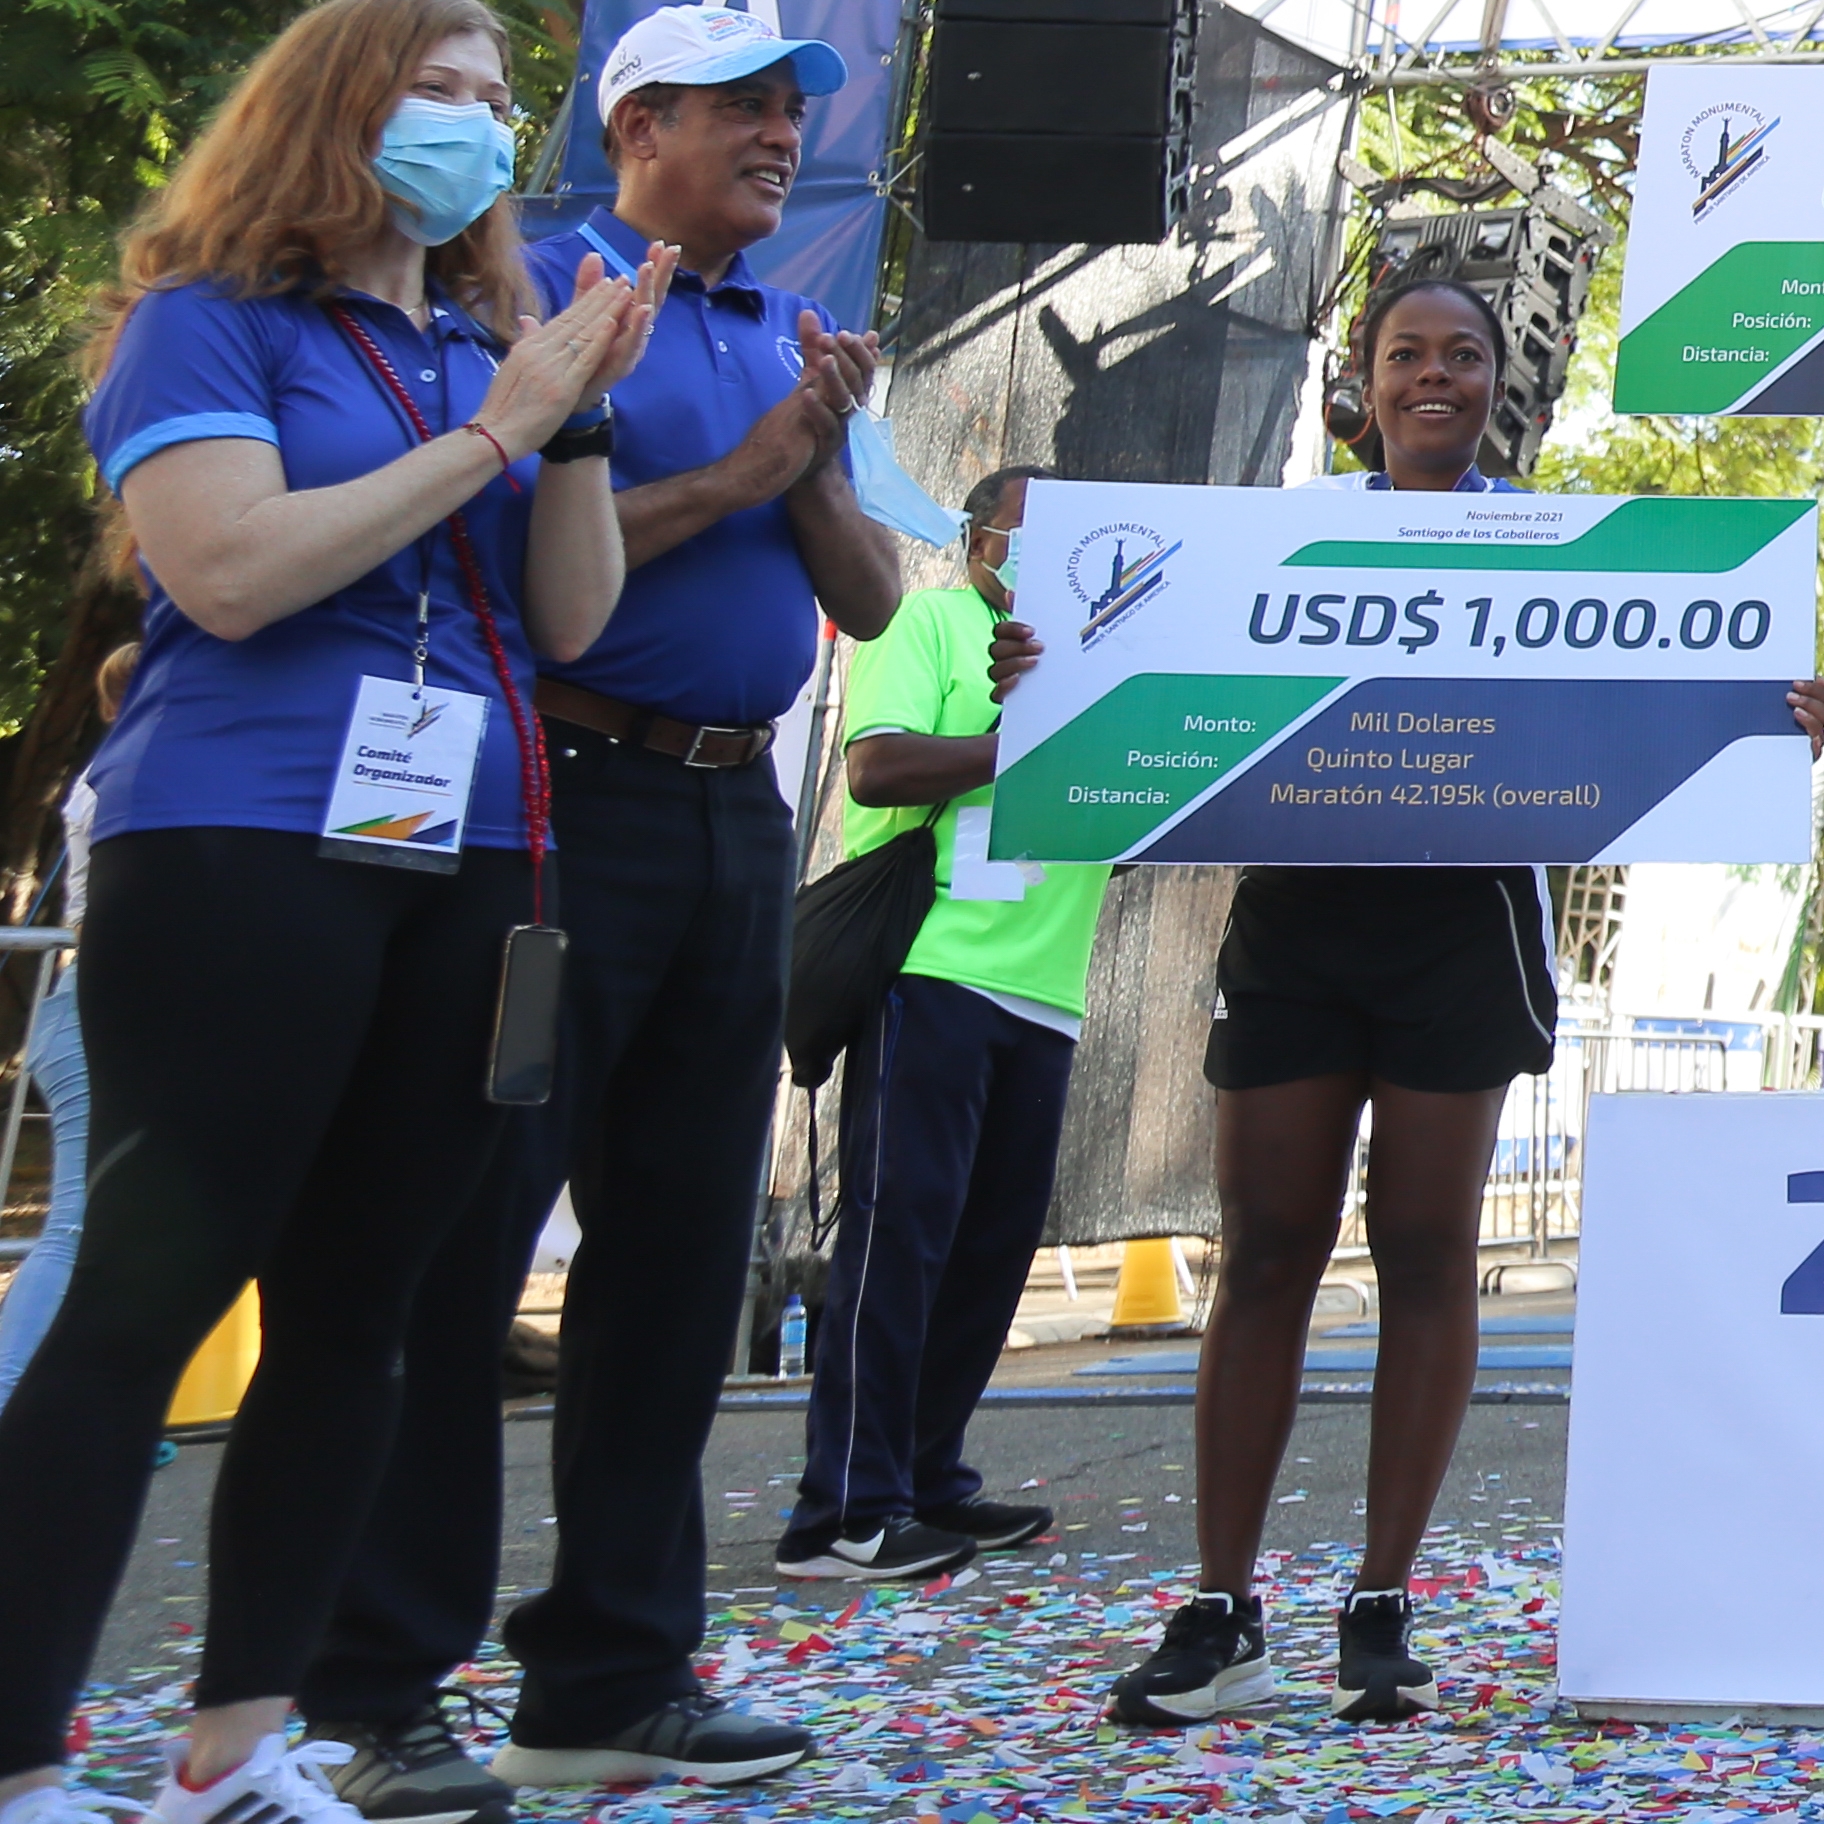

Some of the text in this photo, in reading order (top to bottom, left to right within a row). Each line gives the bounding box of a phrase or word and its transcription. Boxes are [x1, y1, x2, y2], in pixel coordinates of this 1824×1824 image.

[1731, 312, 1811, 330] Posición:
[1681, 346, 1769, 363] Distancia:
[1466, 511, 1562, 521] Noviembre 2021
[1398, 527, 1453, 539] Santiago
[1456, 529, 1470, 538] de
[1473, 529, 1491, 538] los
[1249, 590, 1770, 657] USD$ 1,000.00
[1184, 716, 1256, 732] Monto:
[1351, 712, 1495, 733] Mil Dolares
[357, 745, 412, 764] Comité
[1128, 751, 1218, 768] Posición:
[1308, 748, 1474, 774] Quinto Lugar
[353, 764, 452, 787] Organizador
[1069, 786, 1169, 804] Distancia:
[1271, 783, 1600, 808] Maratón 42.195k (overall)
